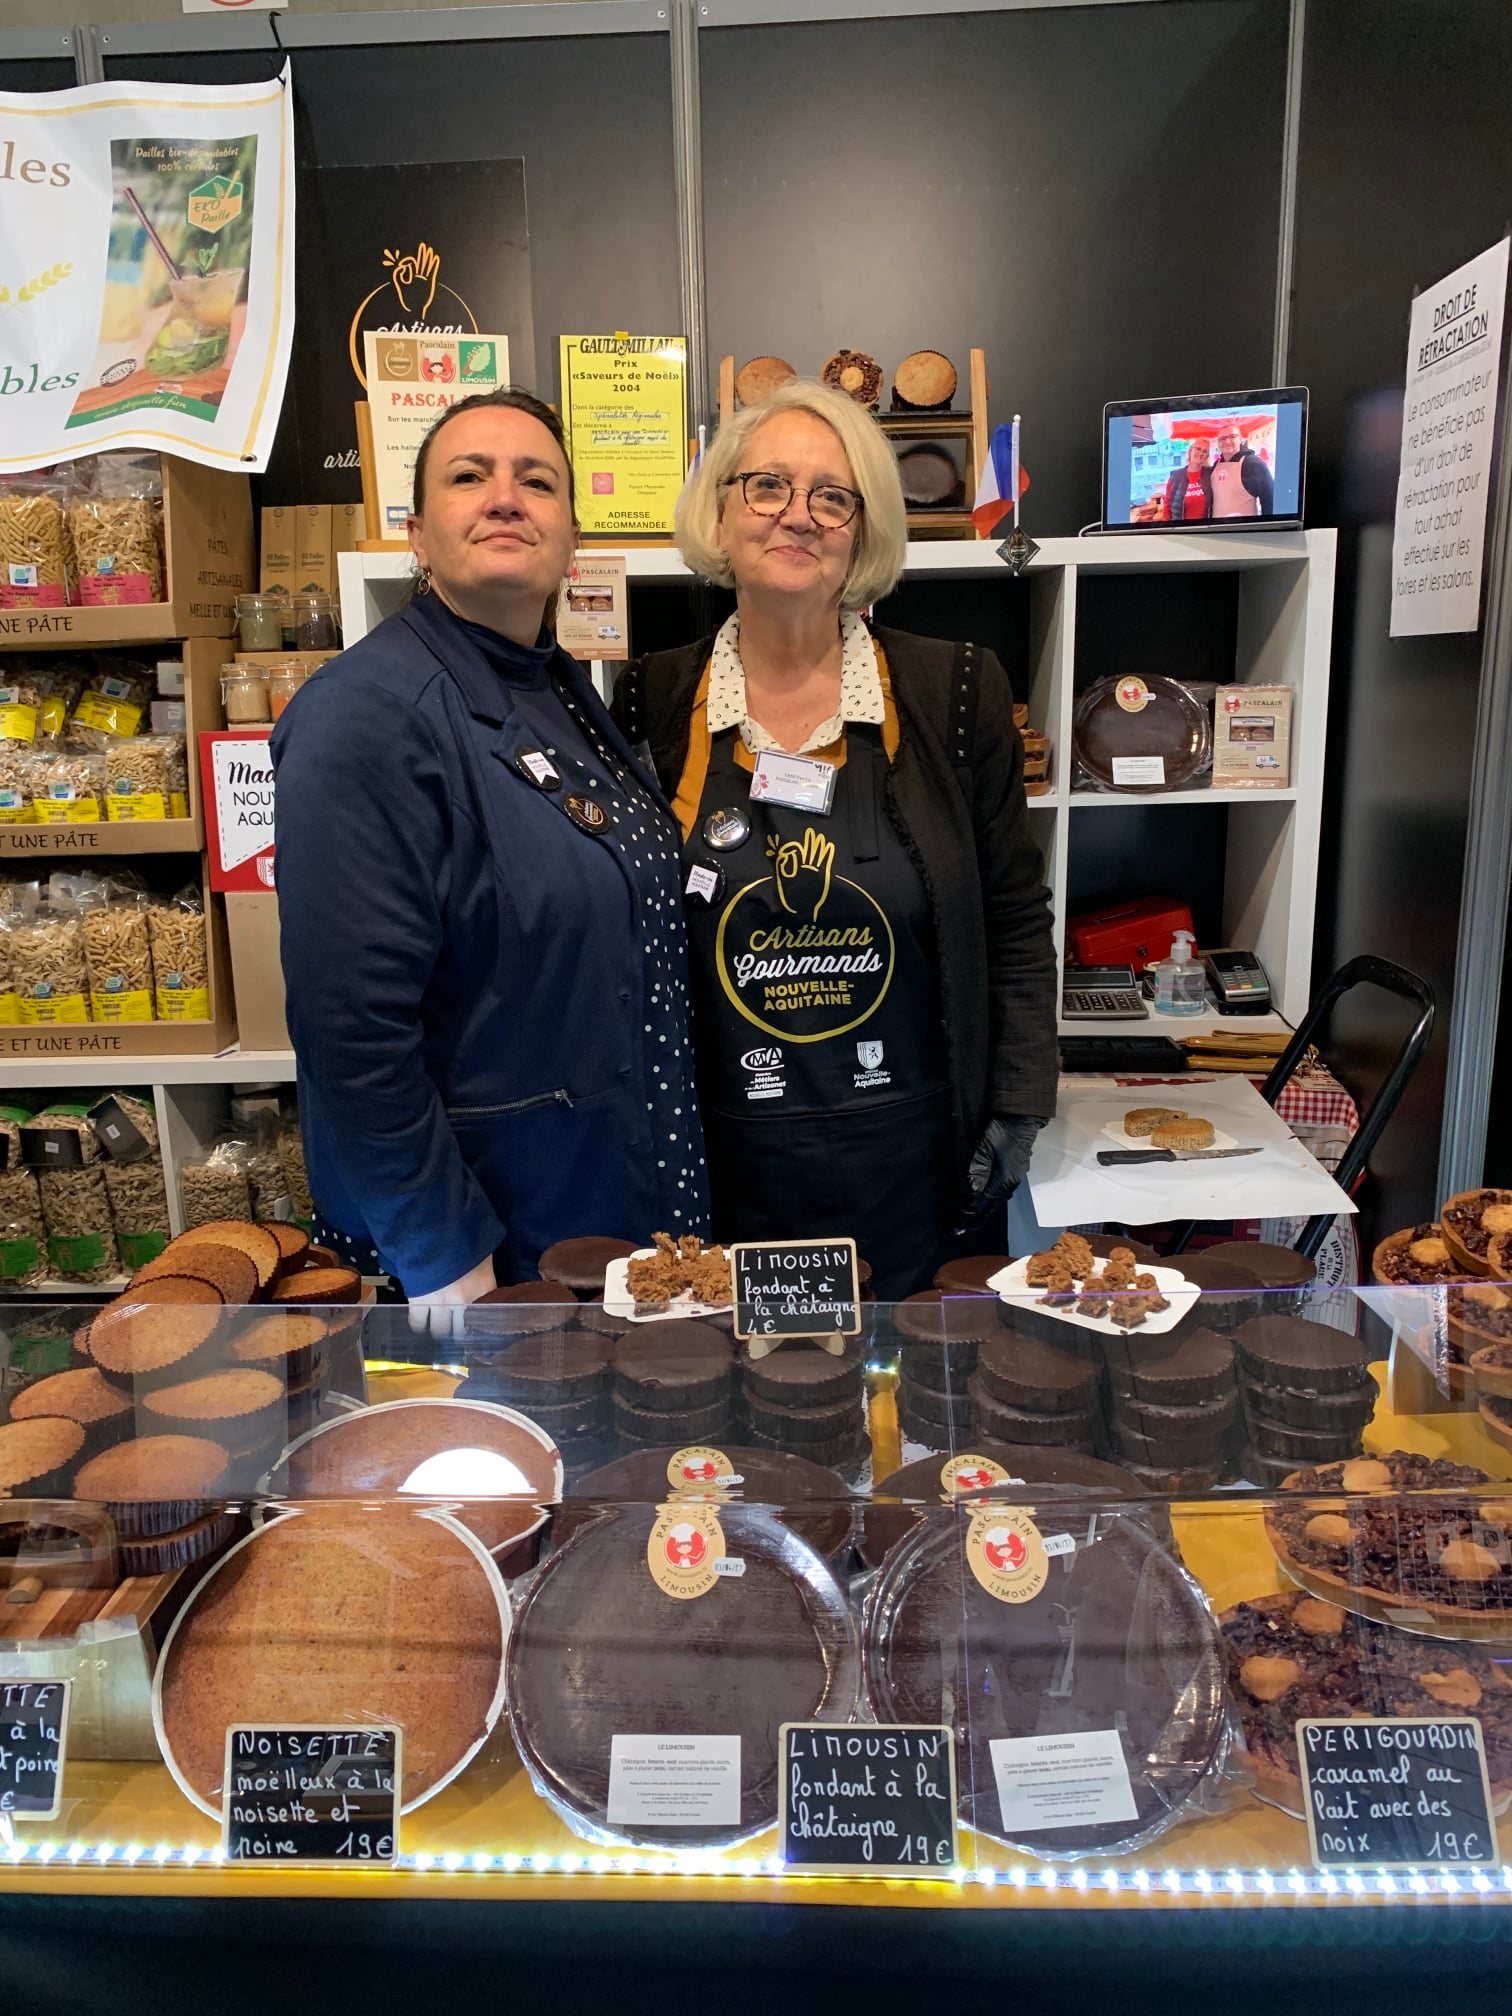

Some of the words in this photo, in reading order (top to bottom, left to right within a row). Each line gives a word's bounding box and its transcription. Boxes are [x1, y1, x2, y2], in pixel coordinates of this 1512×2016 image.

[136, 146, 165, 159] Pailles
[158, 160, 182, 172] 100%
[194, 199, 221, 213] EKO
[200, 209, 232, 225] Paille
[1433, 292, 1462, 328] DROIT
[1463, 283, 1478, 310] DE
[419, 340, 456, 350] Pascalain
[1418, 310, 1489, 367] RÉTRACTATION
[572, 371, 624, 380] «Saveurs
[627, 371, 642, 380] de
[645, 370, 680, 381] Noël»
[614, 359, 638, 368] Prix
[391, 393, 469, 407] PASCAL
[613, 384, 641, 392] 2004
[1407, 402, 1419, 423] Le
[1419, 369, 1493, 418] consommateur
[387, 415, 400, 423] Sur
[401, 415, 412, 423] les
[1407, 432, 1419, 450] ne
[1420, 410, 1464, 446] bénéficie
[1465, 405, 1486, 432] pas
[1436, 443, 1458, 470] droit
[1458, 441, 1473, 462] de
[1403, 479, 1454, 509] rétractation
[1456, 470, 1482, 499] pour
[594, 519, 667, 529] RECOMMANDÉE
[608, 511, 651, 519] ADRESSE
[1413, 516, 1433, 536] tout
[1433, 508, 1463, 532] achat
[207, 537, 229, 556] PÂTES
[1403, 539, 1440, 567] effectué
[1440, 541, 1456, 558] sur
[1455, 536, 1471, 556] les
[197, 570, 243, 588] ARTISANALES
[1395, 573, 1417, 597] foires
[1417, 574, 1428, 589] et
[1428, 571, 1441, 591] les
[189, 602, 212, 618] MELLE
[212, 603, 222, 618] ET
[26, 614, 73, 634] PÂTE
[10, 833, 48, 848] UNE
[53, 830, 99, 849] PÂTE
[749, 924, 874, 952] Artisans
[733, 947, 883, 988] Gourmands
[764, 980, 855, 998] NOUVELLE-
[763, 993, 852, 1011] AQUITAINE
[10, 1038, 31, 1052] ET
[36, 1037, 73, 1051] UNE
[78, 1034, 123, 1051] PÂTE
[853, 1071, 891, 1081] Nouvelle-
[854, 1077, 892, 1089] Aquitaine
[1326, 1240, 1344, 1288] BISTROT
[744, 1274, 811, 1304] fondant
[818, 1275, 836, 1293] à
[754, 1295, 773, 1316] la
[780, 1293, 858, 1327] châtaigne
[672, 1448, 726, 1469] PASCALAIN
[660, 1573, 714, 1594] LIMOUSIN
[988, 1574, 1042, 1598] LIMOUSIN
[10, 1719, 27, 1740] à
[39, 1716, 61, 1743] la
[1306, 1724, 1480, 1753] PERIGOURDIN
[237, 1766, 337, 1791] moëlleux
[347, 1768, 365, 1790] à
[375, 1768, 395, 1793] la
[1310, 1754, 1411, 1785] caramel
[1426, 1766, 1463, 1783] au
[791, 1762, 877, 1814] fondant
[885, 1768, 903, 1798] à
[915, 1762, 948, 1800] la
[233, 1799, 319, 1824] noisette
[330, 1793, 361, 1823] et
[1313, 1789, 1360, 1820] lait
[1369, 1801, 1414, 1819] avec
[1416, 1789, 1453, 1817] des
[790, 1800, 900, 1861] châtaigne
[1321, 1825, 1371, 1853] noix
[1426, 1831, 1484, 1860] 19€
[234, 1833, 298, 1860] poire
[335, 1831, 394, 1859] 19€
[897, 1833, 952, 1864] 19€
